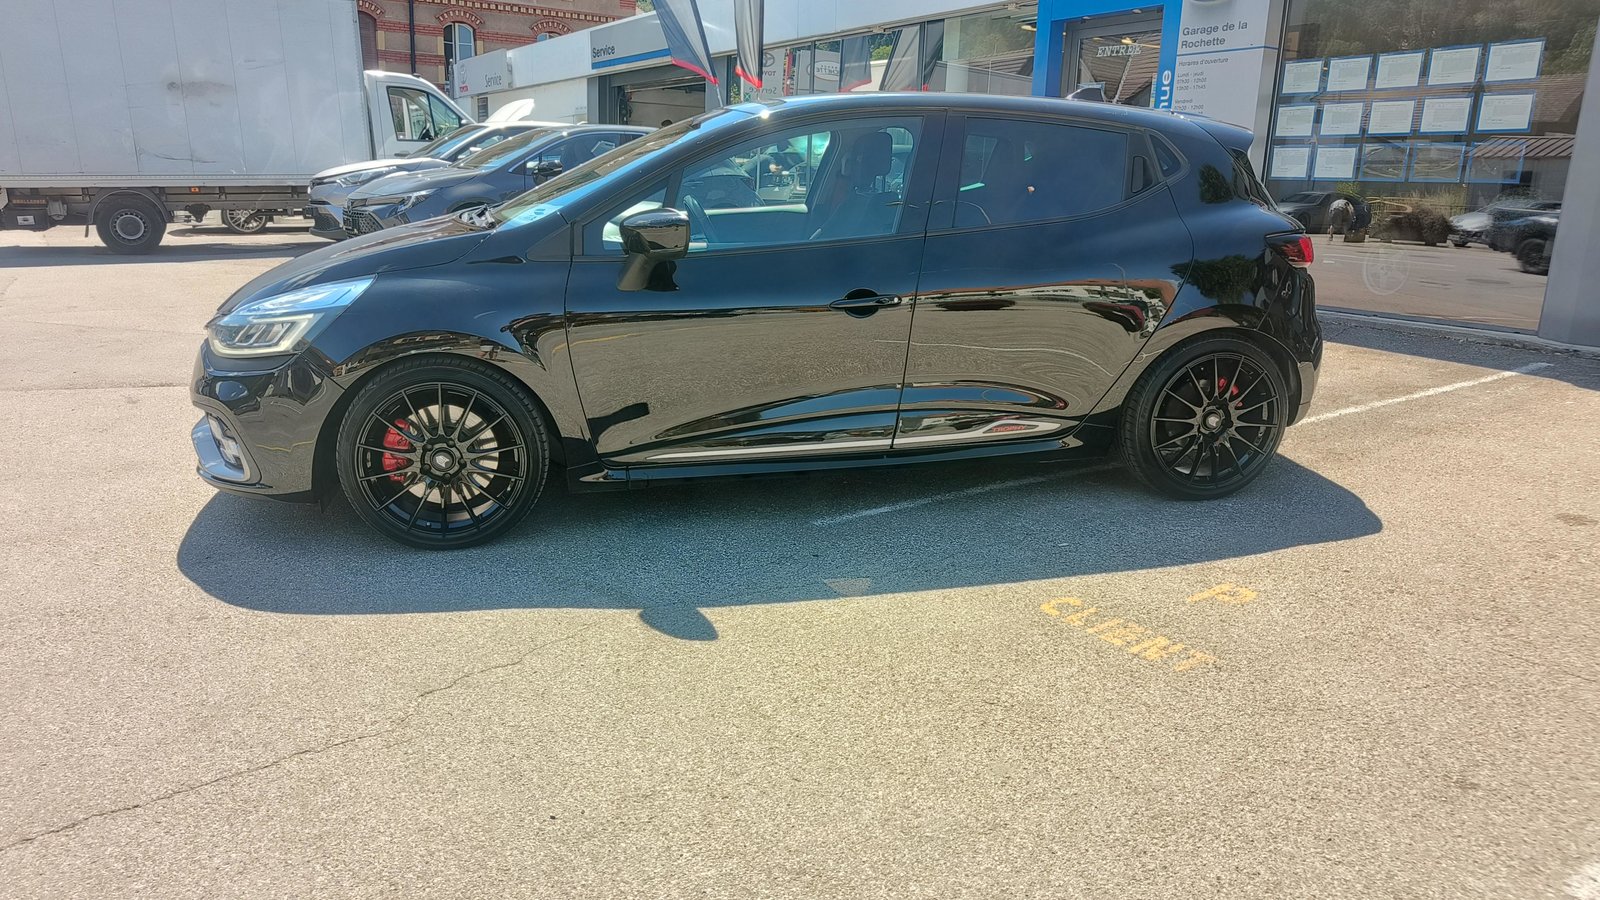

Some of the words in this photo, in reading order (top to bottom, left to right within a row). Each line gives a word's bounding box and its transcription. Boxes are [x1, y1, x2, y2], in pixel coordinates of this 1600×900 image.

[1182, 25, 1219, 36] Garage
[1221, 22, 1235, 32] de
[1238, 21, 1248, 30] la
[1181, 37, 1226, 49] Rochette
[592, 44, 616, 58] Service
[484, 73, 502, 88] Service
[1040, 597, 1217, 673] CLIENT
